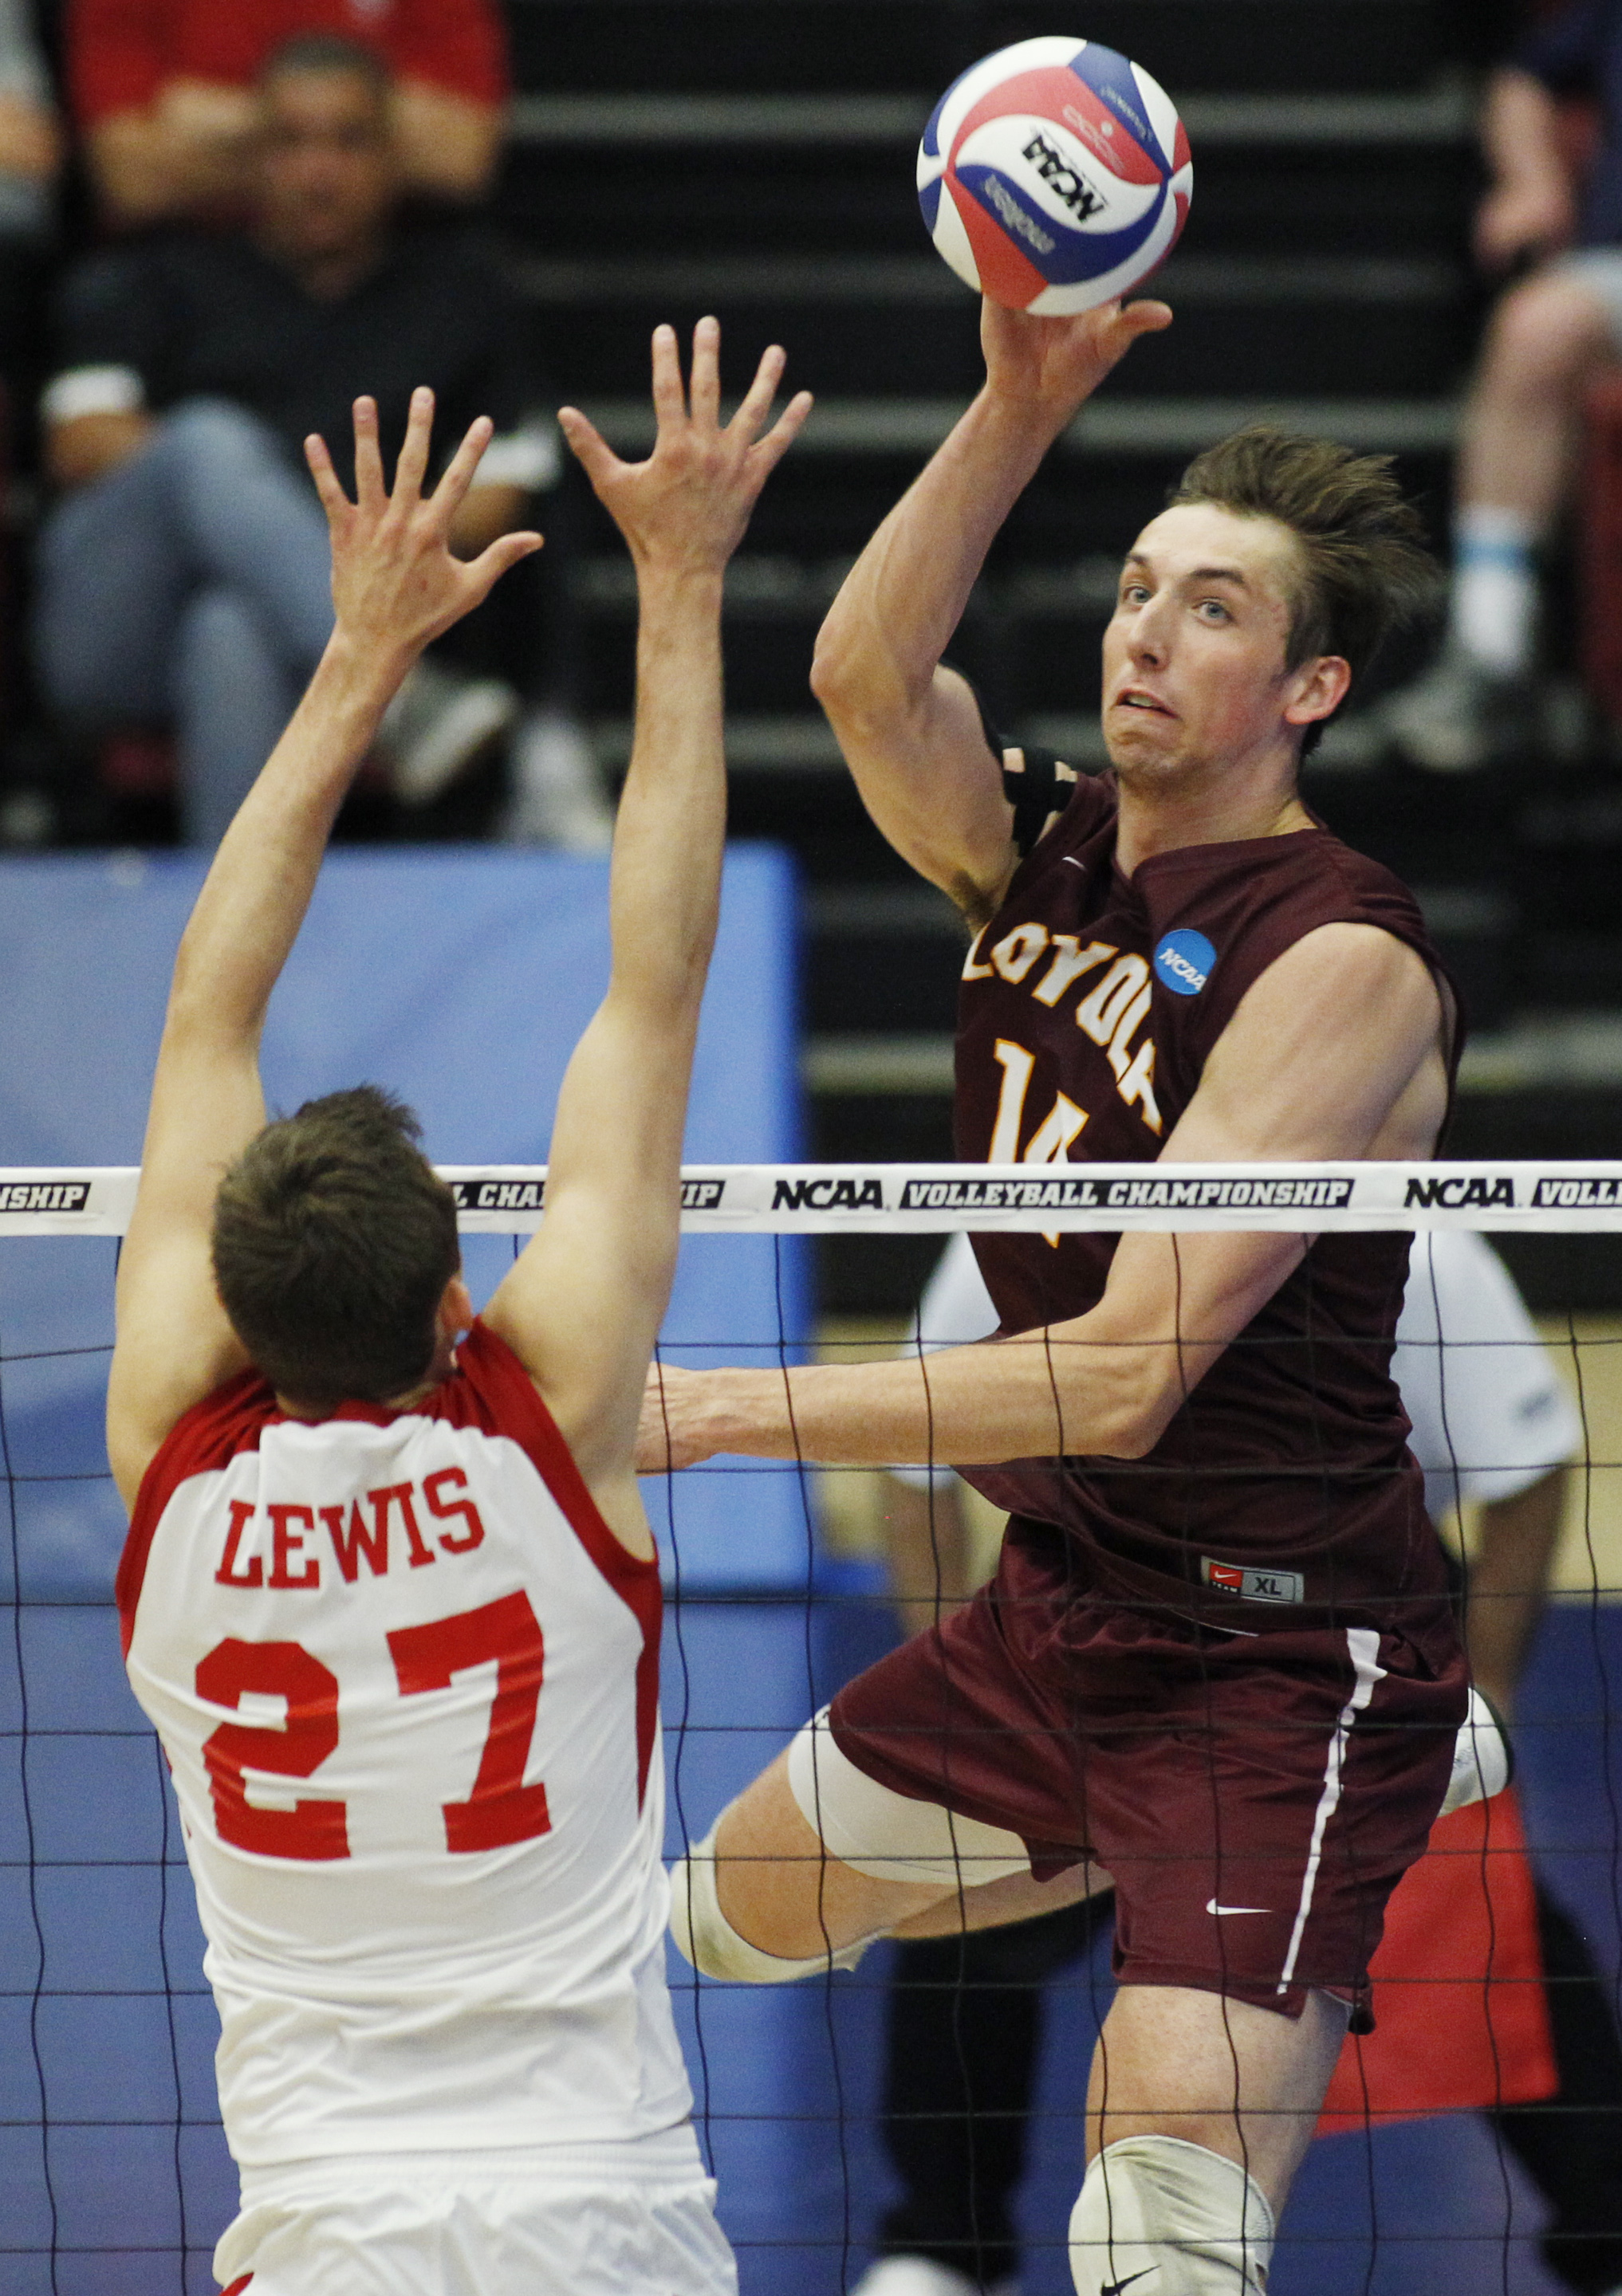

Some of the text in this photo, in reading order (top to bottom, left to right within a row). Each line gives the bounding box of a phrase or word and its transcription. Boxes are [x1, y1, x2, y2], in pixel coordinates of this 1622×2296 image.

[1022, 134, 1104, 222] NCAA
[1158, 948, 1207, 990] NCAA
[961, 922, 1163, 1138] LOYOLA
[770, 1179, 883, 1210] NCAA
[907, 1181, 1098, 1207] VOLLEYBALL
[1106, 1180, 1349, 1206] CHAMPIONSHIP
[1403, 1178, 1515, 1208] NCAA
[215, 1466, 485, 1589] LEWIS
[1254, 1576, 1282, 1596] XL
[195, 1589, 553, 1862] 27
